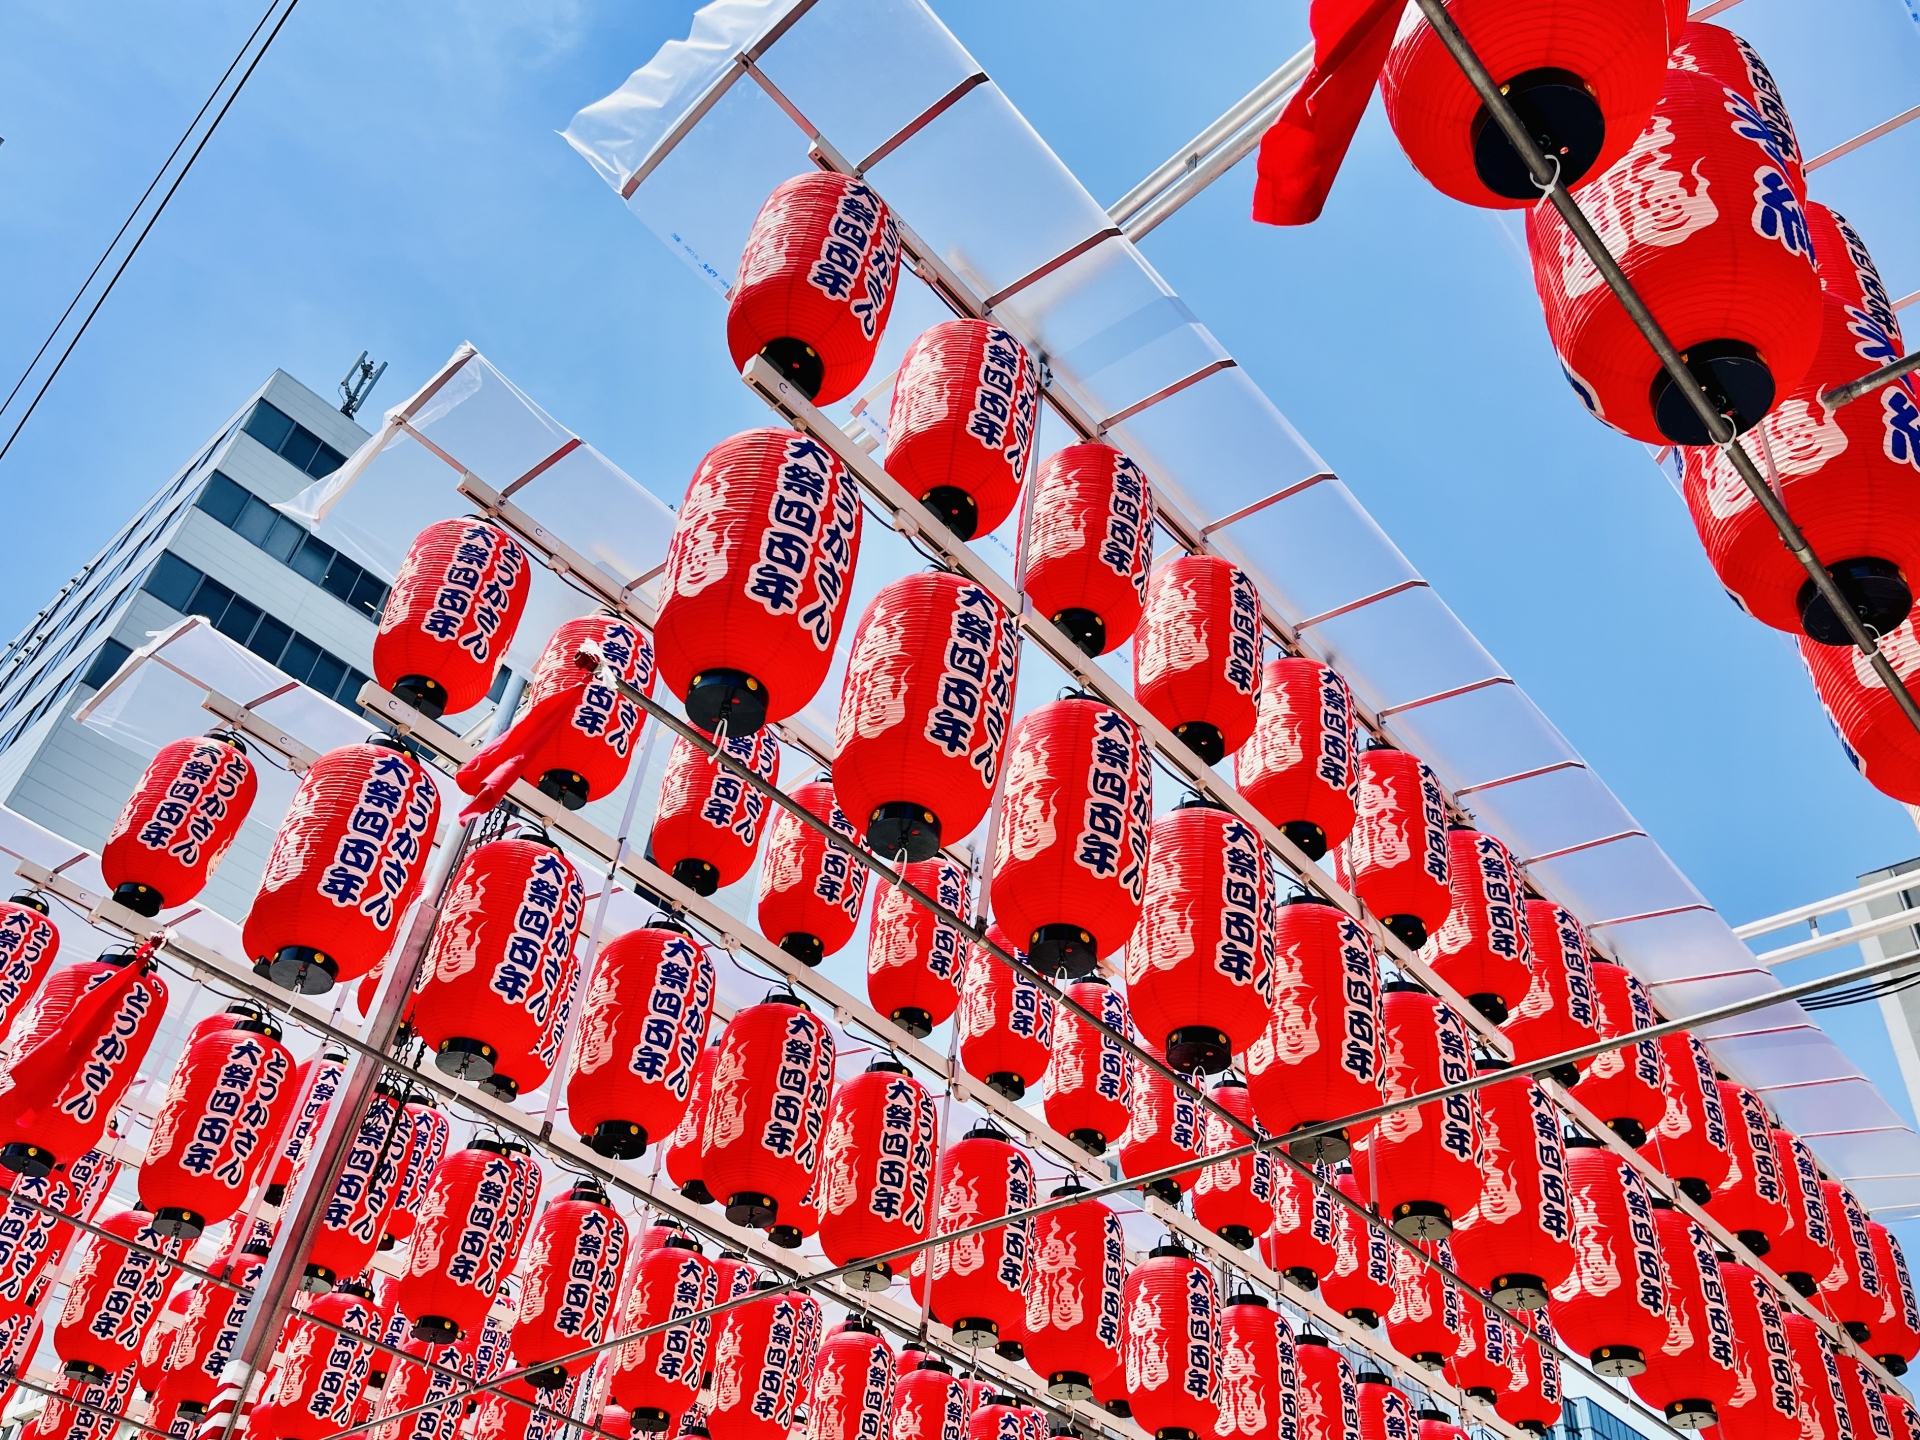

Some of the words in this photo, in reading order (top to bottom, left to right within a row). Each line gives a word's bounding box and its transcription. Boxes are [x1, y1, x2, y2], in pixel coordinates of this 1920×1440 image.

[812, 182, 880, 298] 大祭四百年
[970, 327, 1018, 447] 大祭四百年
[752, 438, 827, 611] 大祭四百年
[803, 464, 860, 645] とうかさん
[1103, 455, 1142, 572] 大祭四百年
[425, 527, 495, 639] 大祭四百年
[462, 539, 521, 659] とうかさん
[1229, 571, 1258, 691] 大祭四百年
[926, 584, 997, 752] 大祭四百年
[975, 612, 1019, 785] とうかさん
[1320, 670, 1346, 787] 大祭四百年
[141, 745, 221, 845] 大祭四百年
[178, 756, 249, 863] とうかさん
[323, 760, 408, 903] 大祭四百年
[365, 775, 436, 926] とうかさん
[1080, 711, 1128, 873] 大祭四百年
[1420, 762, 1446, 882] 大祭四百年
[529, 870, 583, 1021] とうかさん
[540, 856, 566, 1001] 大祭四百年
[1219, 822, 1257, 980] 大祭四百年
[1481, 838, 1515, 959] 大祭四百年
[632, 940, 693, 1080] 大祭四百年
[668, 951, 714, 1097] とうかさん
[1340, 920, 1373, 1081] 大祭四百年
[1554, 909, 1590, 1026] 大祭四百年
[66, 985, 149, 1118] とうかさん
[184, 1042, 261, 1172] 大祭四百年
[788, 1016, 813, 1153] 大祭四百年
[794, 1028, 833, 1168] とうかさん
[1690, 1037, 1725, 1148] 大祭四百年
[217, 1051, 286, 1185] とうかさん
[888, 1081, 913, 1218] 大祭四百年
[906, 1089, 934, 1231] とうかさん
[1531, 1087, 1567, 1236] 大祭四百年
[1741, 1091, 1779, 1202] 大祭四百年
[451, 1159, 510, 1283] 大祭四百年
[477, 1172, 525, 1296] とうかさん
[1620, 1165, 1661, 1311] 大祭四百年
[1793, 1139, 1827, 1244] 大祭四百年
[1842, 1191, 1879, 1294] 大祭四百年
[558, 1212, 606, 1334] 大祭四百年
[584, 1219, 624, 1345] とうかさん
[1100, 1216, 1120, 1343] 大祭四百年
[1186, 1270, 1207, 1398] 大祭四百年
[1690, 1224, 1732, 1366] 大祭四百年
[1888, 1231, 1918, 1332] 大祭四百年
[754, 1303, 796, 1418] 大祭四百年
[777, 1311, 808, 1428] とうかさん
[1754, 1281, 1797, 1414] 大祭四百年
